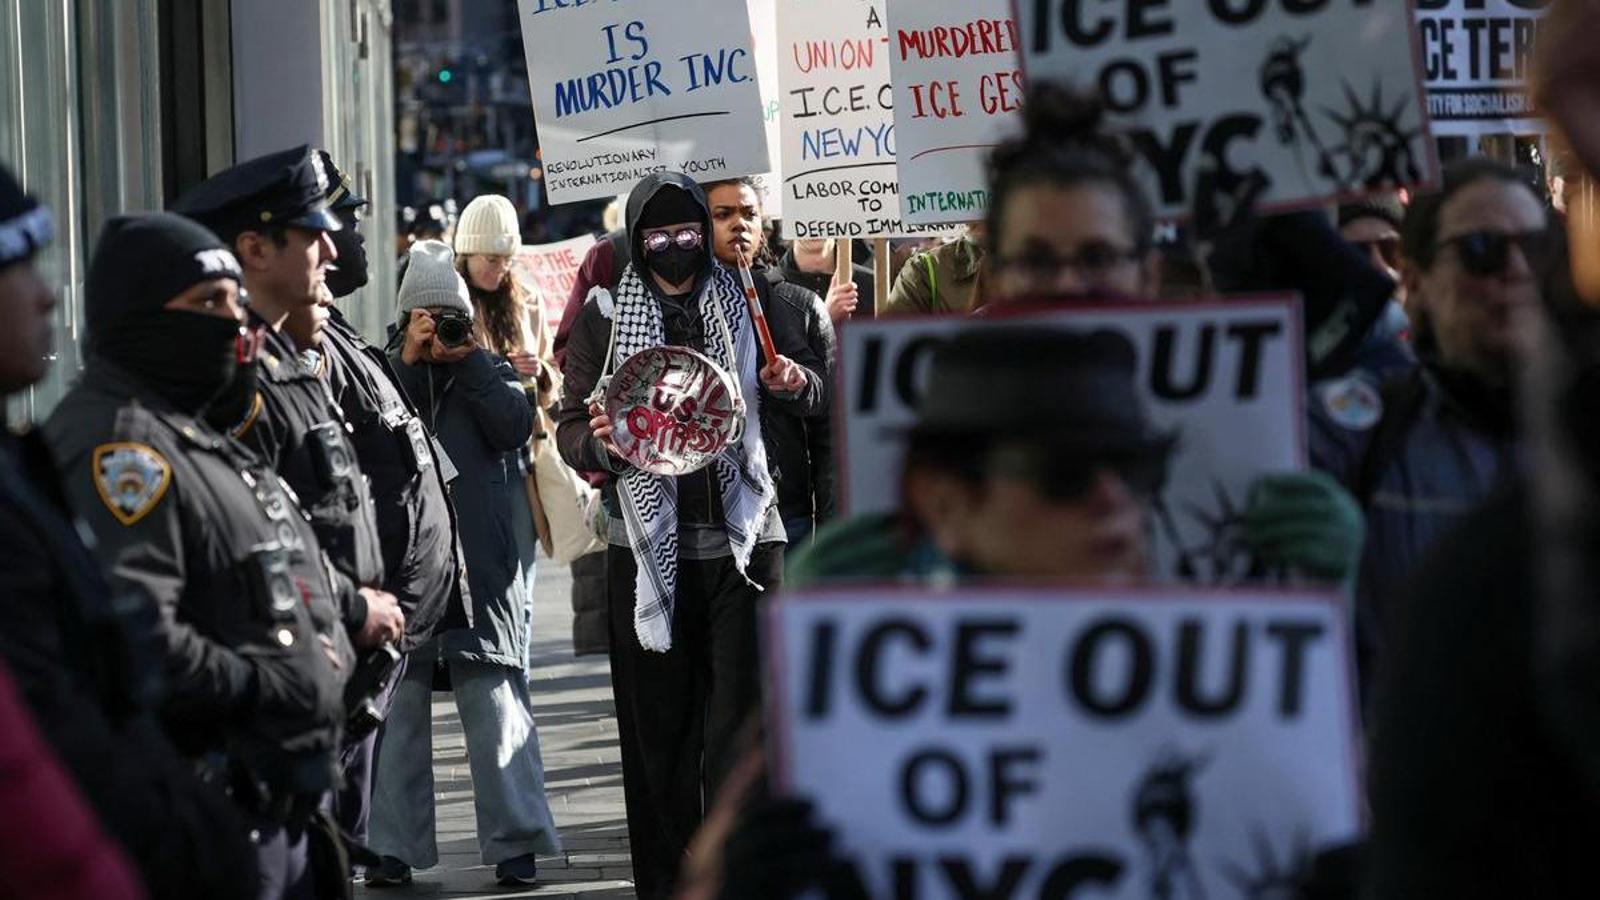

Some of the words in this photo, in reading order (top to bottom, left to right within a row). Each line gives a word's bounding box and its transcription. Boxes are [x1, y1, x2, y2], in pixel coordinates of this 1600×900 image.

[867, 6, 881, 28] A
[601, 21, 648, 64] IS
[793, 38, 873, 72] UNION
[1420, 18, 1457, 80] CE
[556, 61, 671, 118] MURDER
[679, 48, 754, 92] INC.
[1100, 50, 1199, 113] OF
[790, 85, 870, 118] I.C.E.
[802, 126, 863, 160] NEW
[1127, 113, 1272, 204] YC
[547, 148, 657, 174] REVOLUTIONARY
[679, 157, 726, 175] YOUTH
[792, 180, 856, 200] LABOR
[859, 180, 899, 196] COM
[858, 198, 882, 212] TO
[795, 220, 862, 238] DEFEND
[1148, 320, 1280, 403] UT
[804, 613, 1022, 721] ICE
[1065, 612, 1323, 722] OUT
[895, 746, 1044, 830] OF
